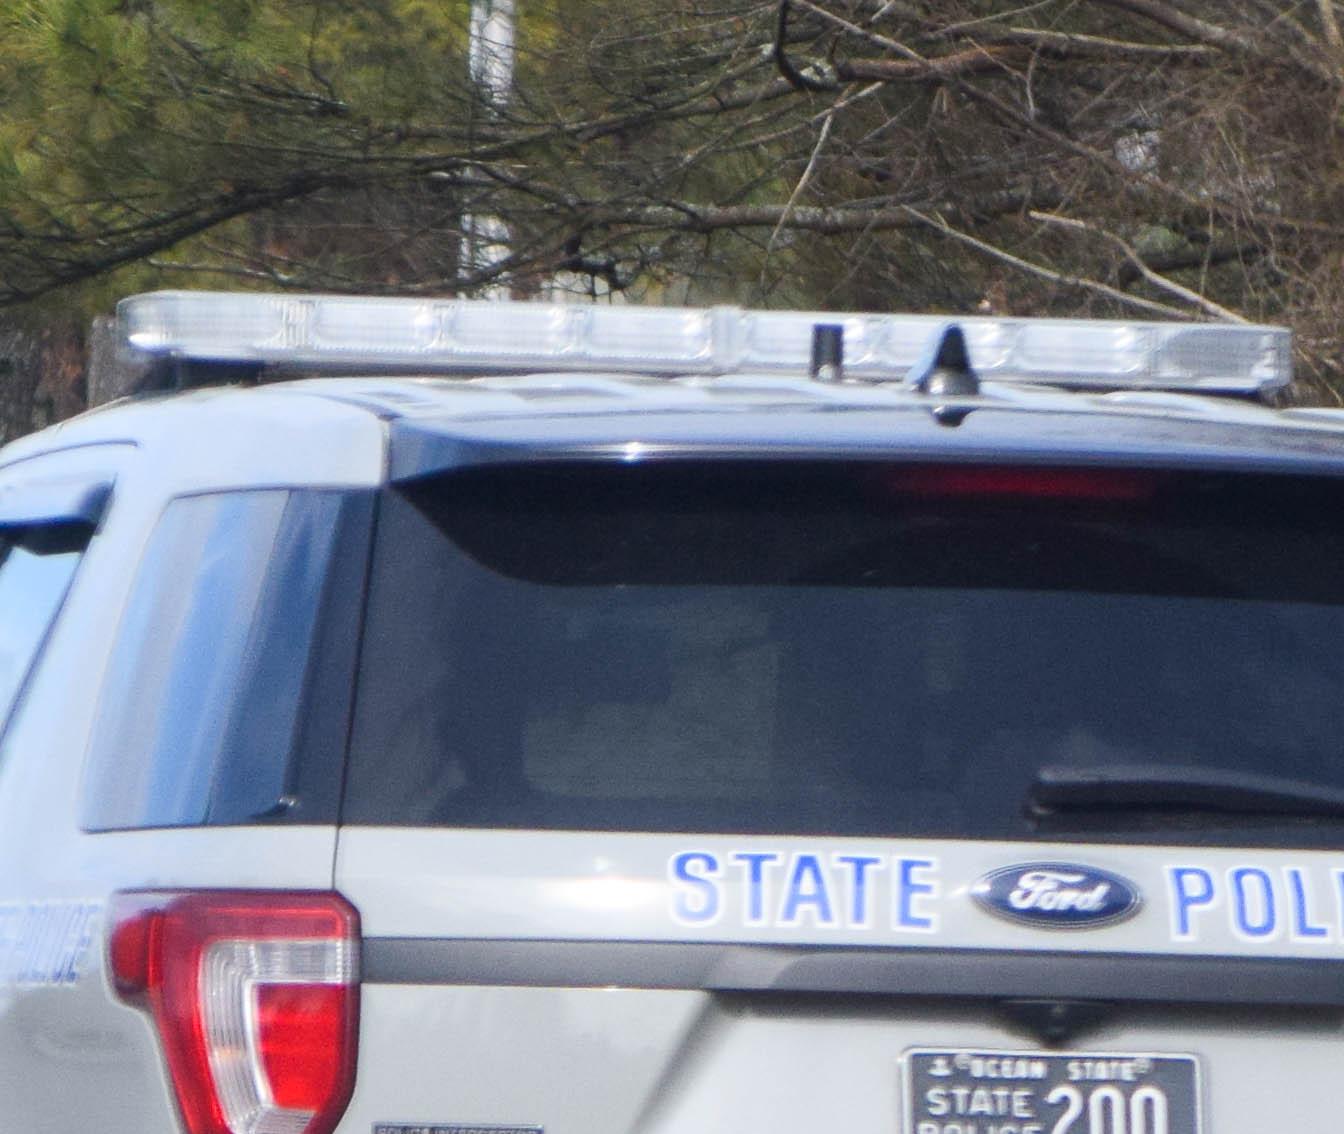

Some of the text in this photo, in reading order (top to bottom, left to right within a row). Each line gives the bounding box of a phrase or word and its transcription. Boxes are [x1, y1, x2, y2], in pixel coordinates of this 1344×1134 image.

[671, 850, 935, 929] STATE
[1008, 871, 1111, 911] Ford
[970, 1058, 1138, 1081] OCEAN STATE
[925, 1088, 1035, 1117] STATE
